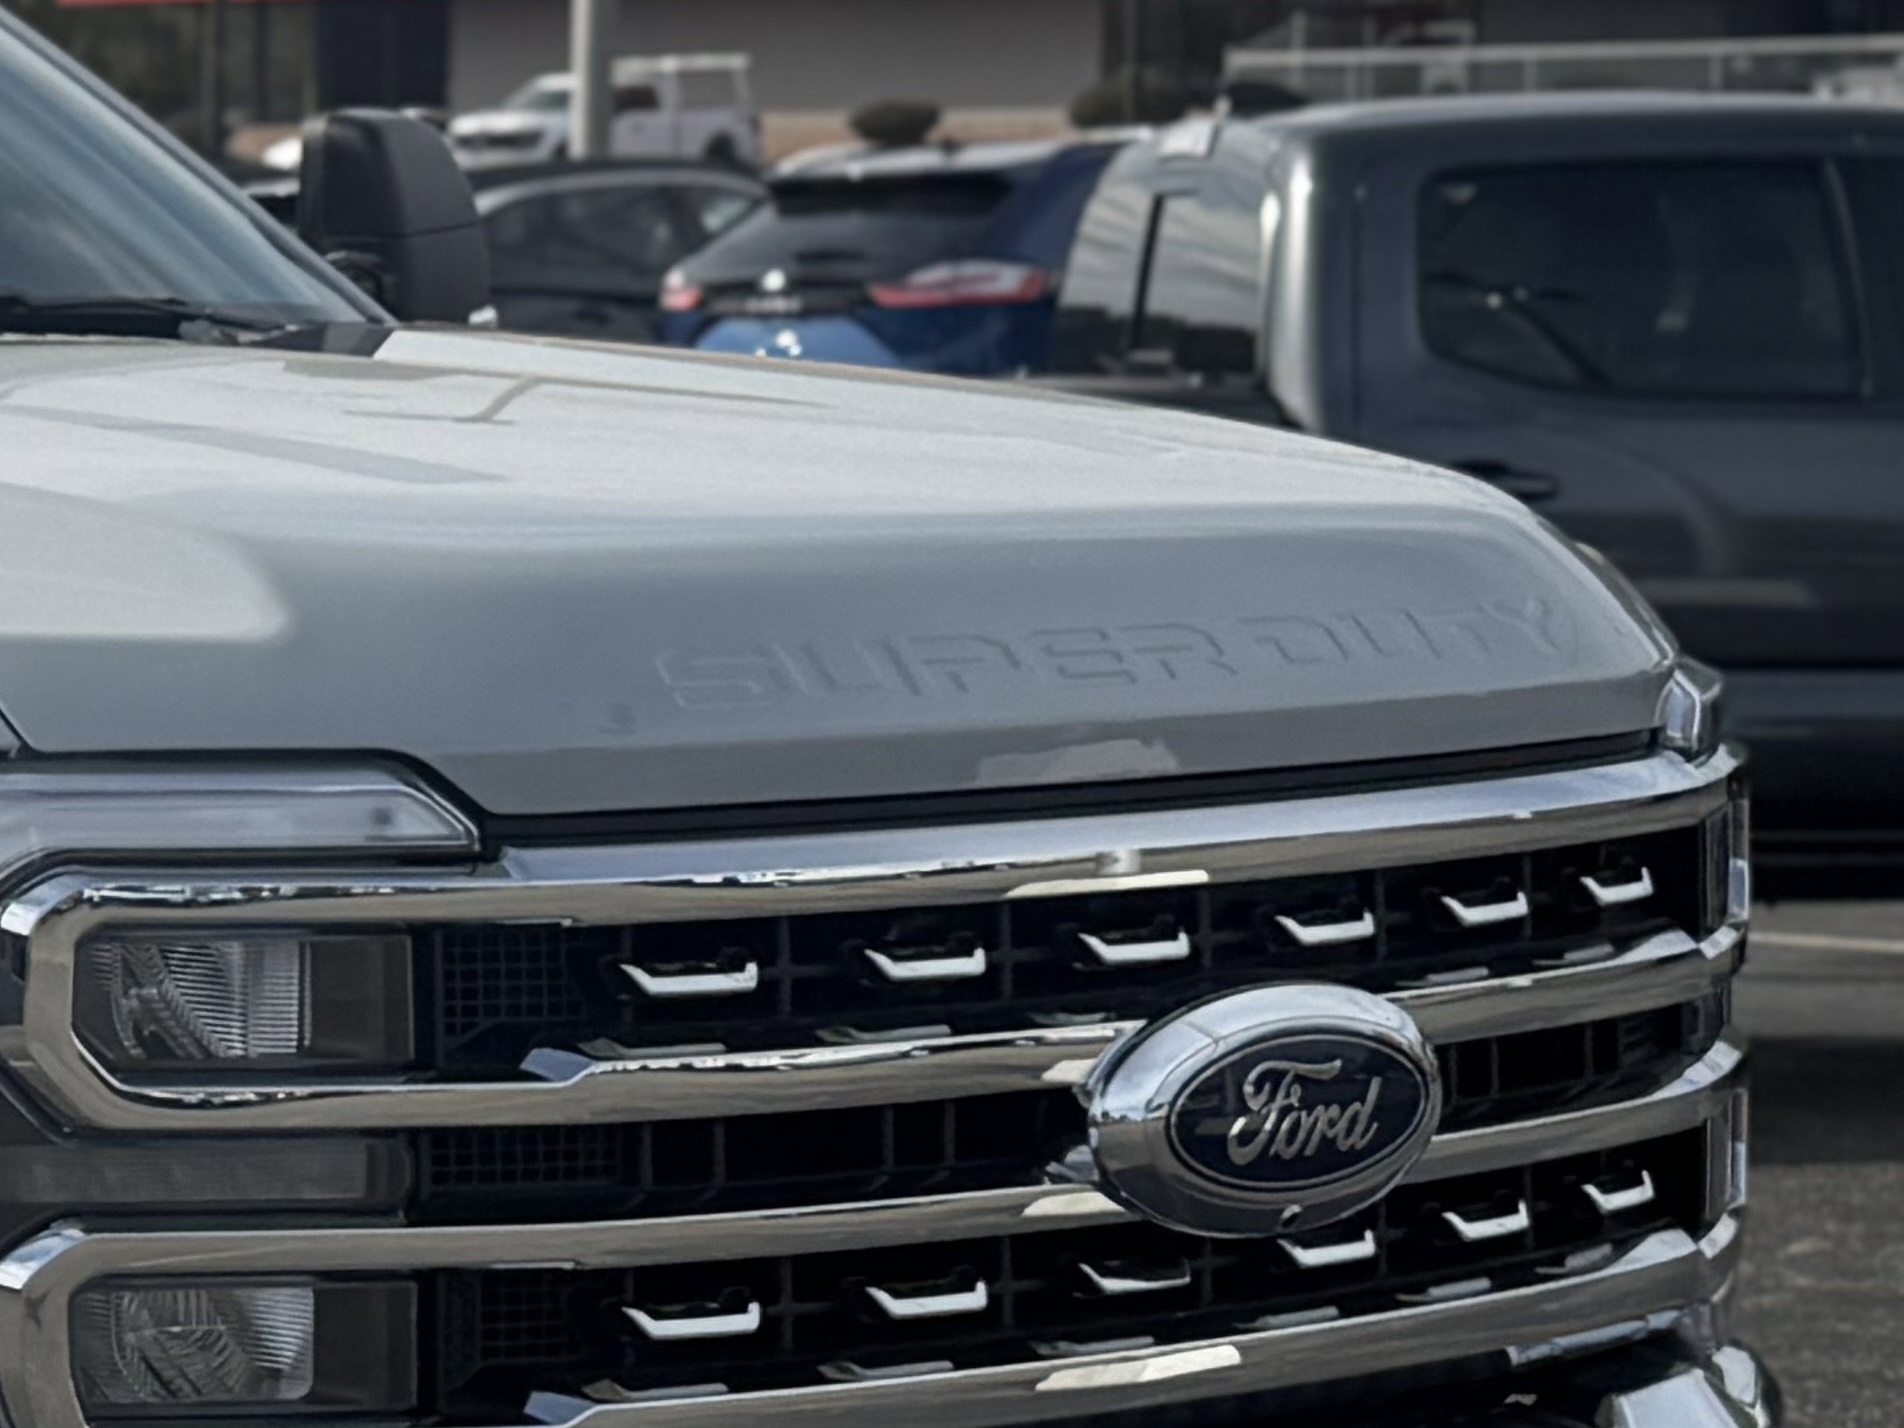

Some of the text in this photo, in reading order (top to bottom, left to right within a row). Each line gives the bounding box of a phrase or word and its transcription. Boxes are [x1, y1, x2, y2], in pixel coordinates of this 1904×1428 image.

[654, 594, 1558, 714] SUPER DUTY
[1227, 1058, 1382, 1165] Ford
